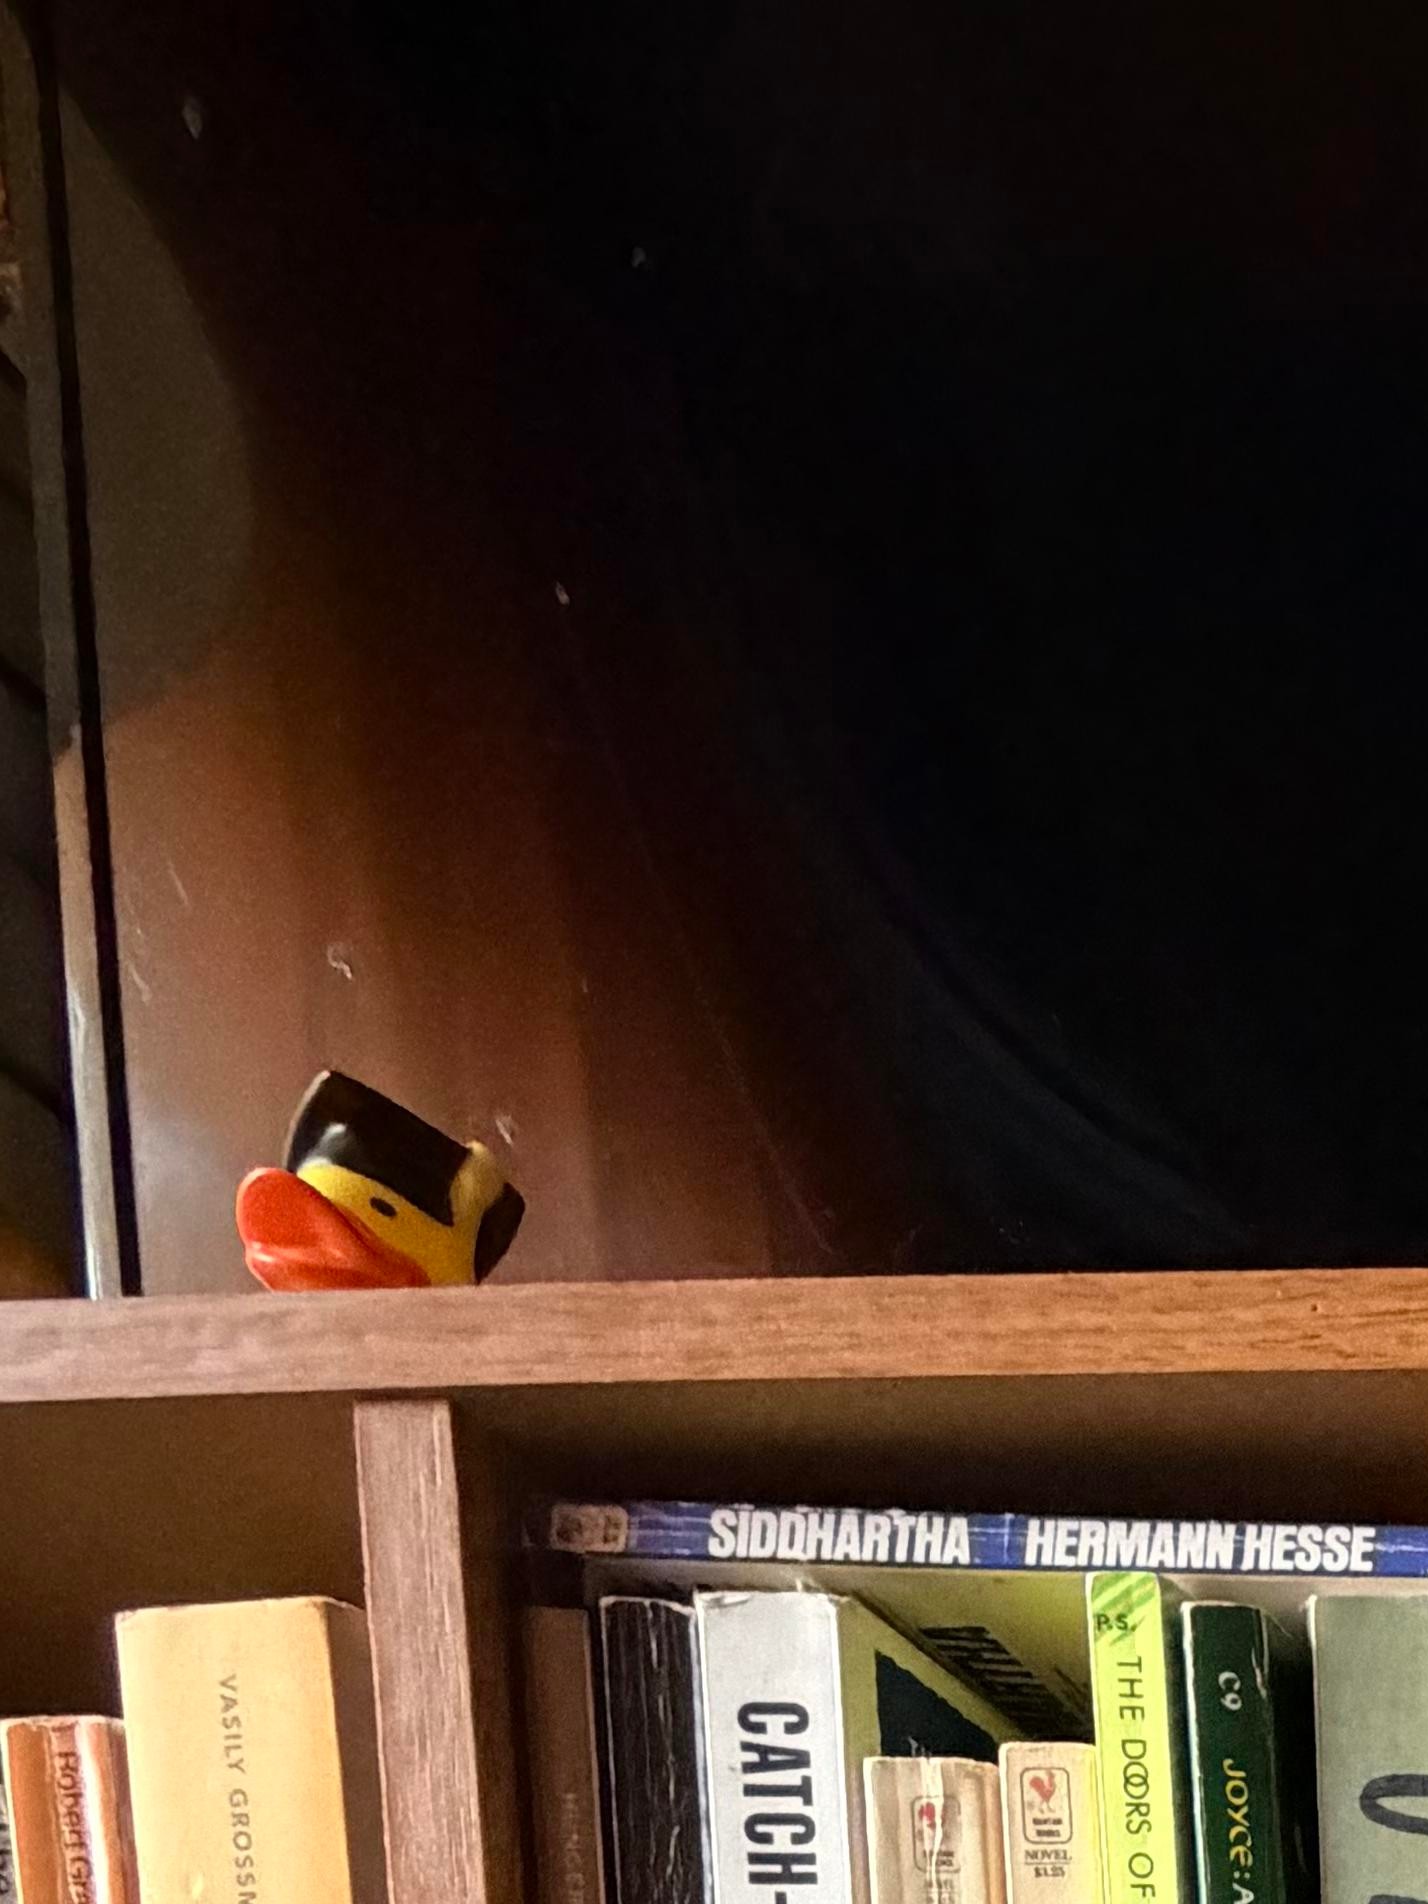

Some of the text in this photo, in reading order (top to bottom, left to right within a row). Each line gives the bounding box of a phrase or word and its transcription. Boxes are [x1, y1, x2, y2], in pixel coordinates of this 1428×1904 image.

[709, 1507, 1377, 1573] SIDDHARTHA HERMANN HESSE
[219, 1672, 247, 1775] VASILY
